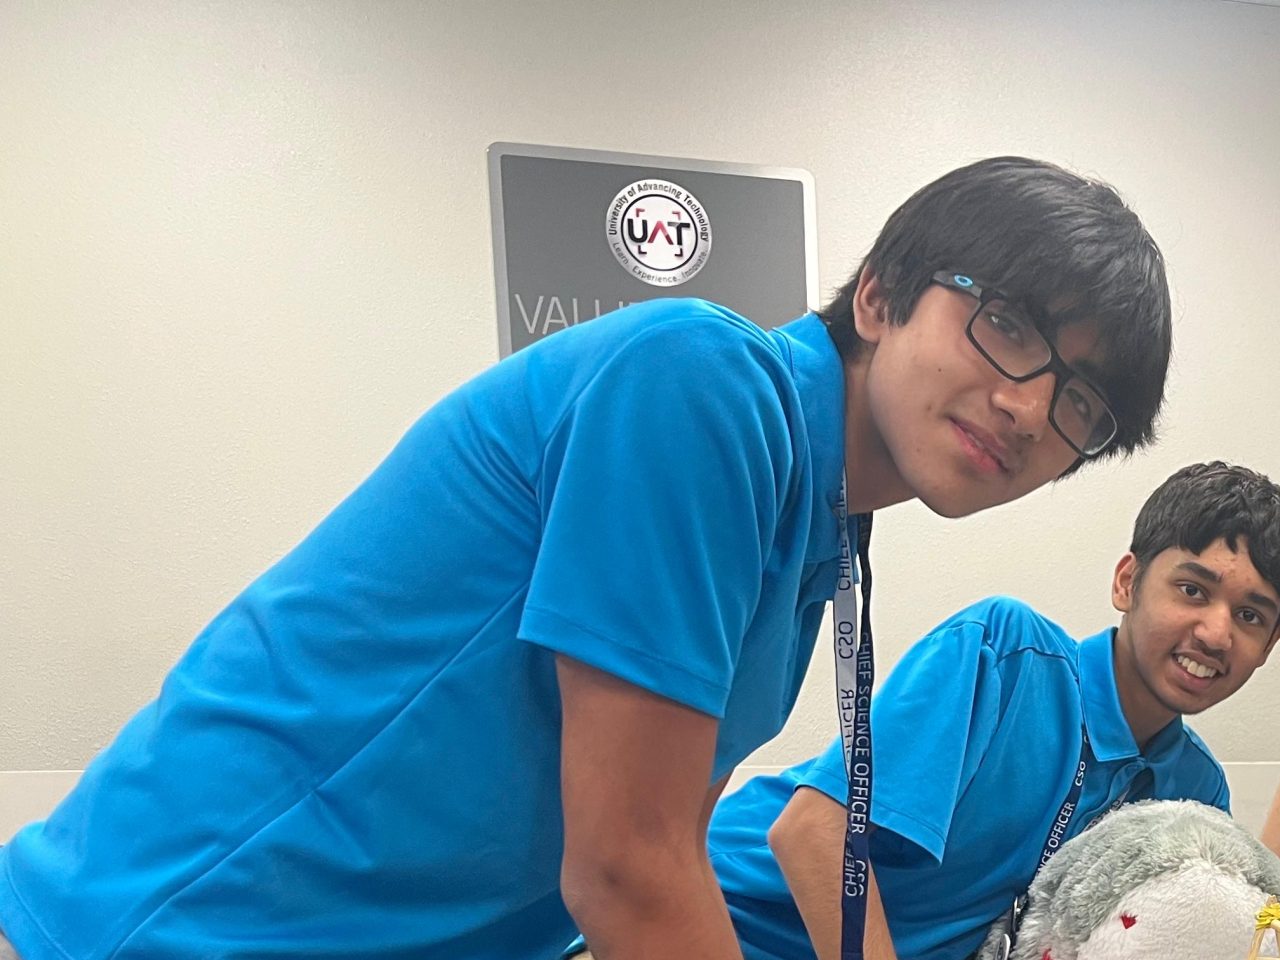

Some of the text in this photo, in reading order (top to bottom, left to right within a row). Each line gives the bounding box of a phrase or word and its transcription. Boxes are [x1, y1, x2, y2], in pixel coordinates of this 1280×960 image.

[609, 182, 708, 242] University of Advancing Technology
[858, 632, 873, 680] CHIEF
[854, 685, 871, 757] SCIENCE
[850, 762, 870, 834] OFFICER
[1048, 801, 1075, 848] OFFICER
[1075, 761, 1087, 787] CSO
